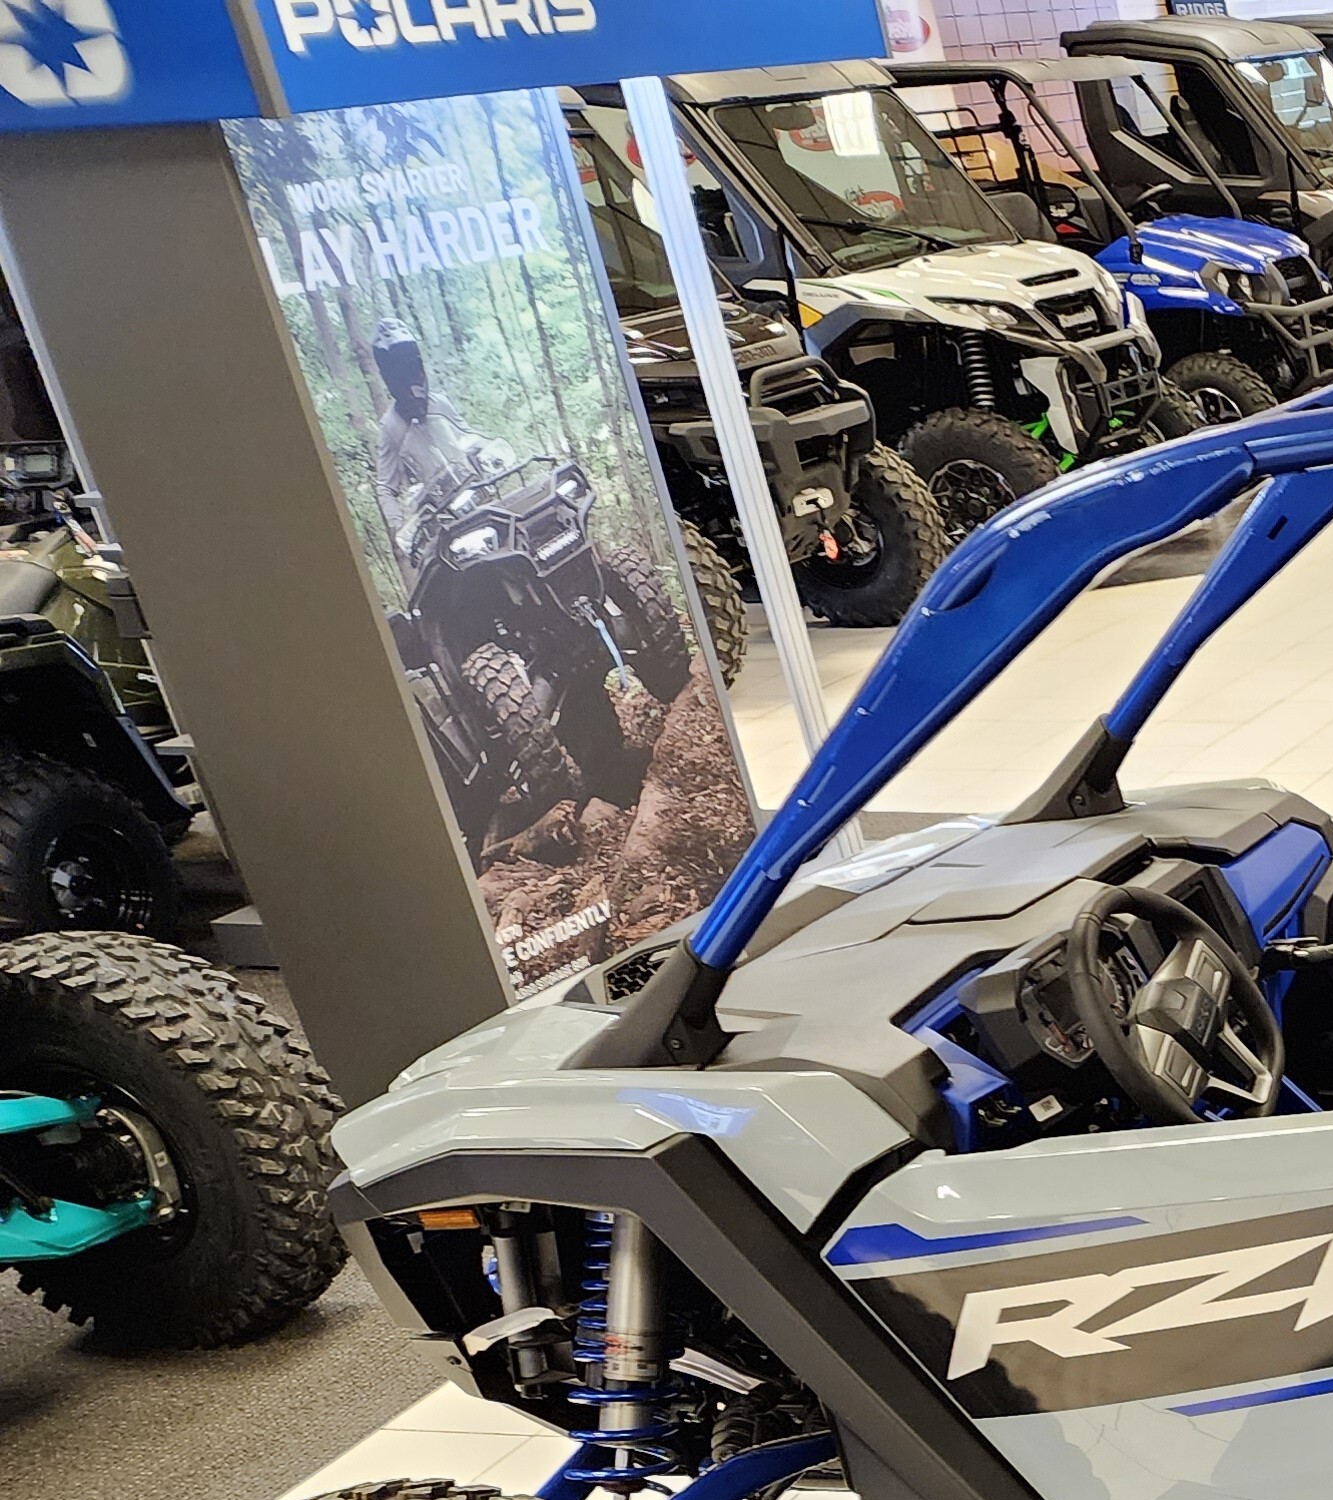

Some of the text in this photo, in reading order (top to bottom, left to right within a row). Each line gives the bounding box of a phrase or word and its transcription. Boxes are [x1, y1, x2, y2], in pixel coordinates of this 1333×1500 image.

[275, 0, 597, 53] POLARIS
[285, 162, 468, 216] WORK SMARTER
[257, 197, 552, 297] LAY HARDER
[736, 344, 778, 364] an-am
[515, 898, 612, 962] CONFIDENTLY
